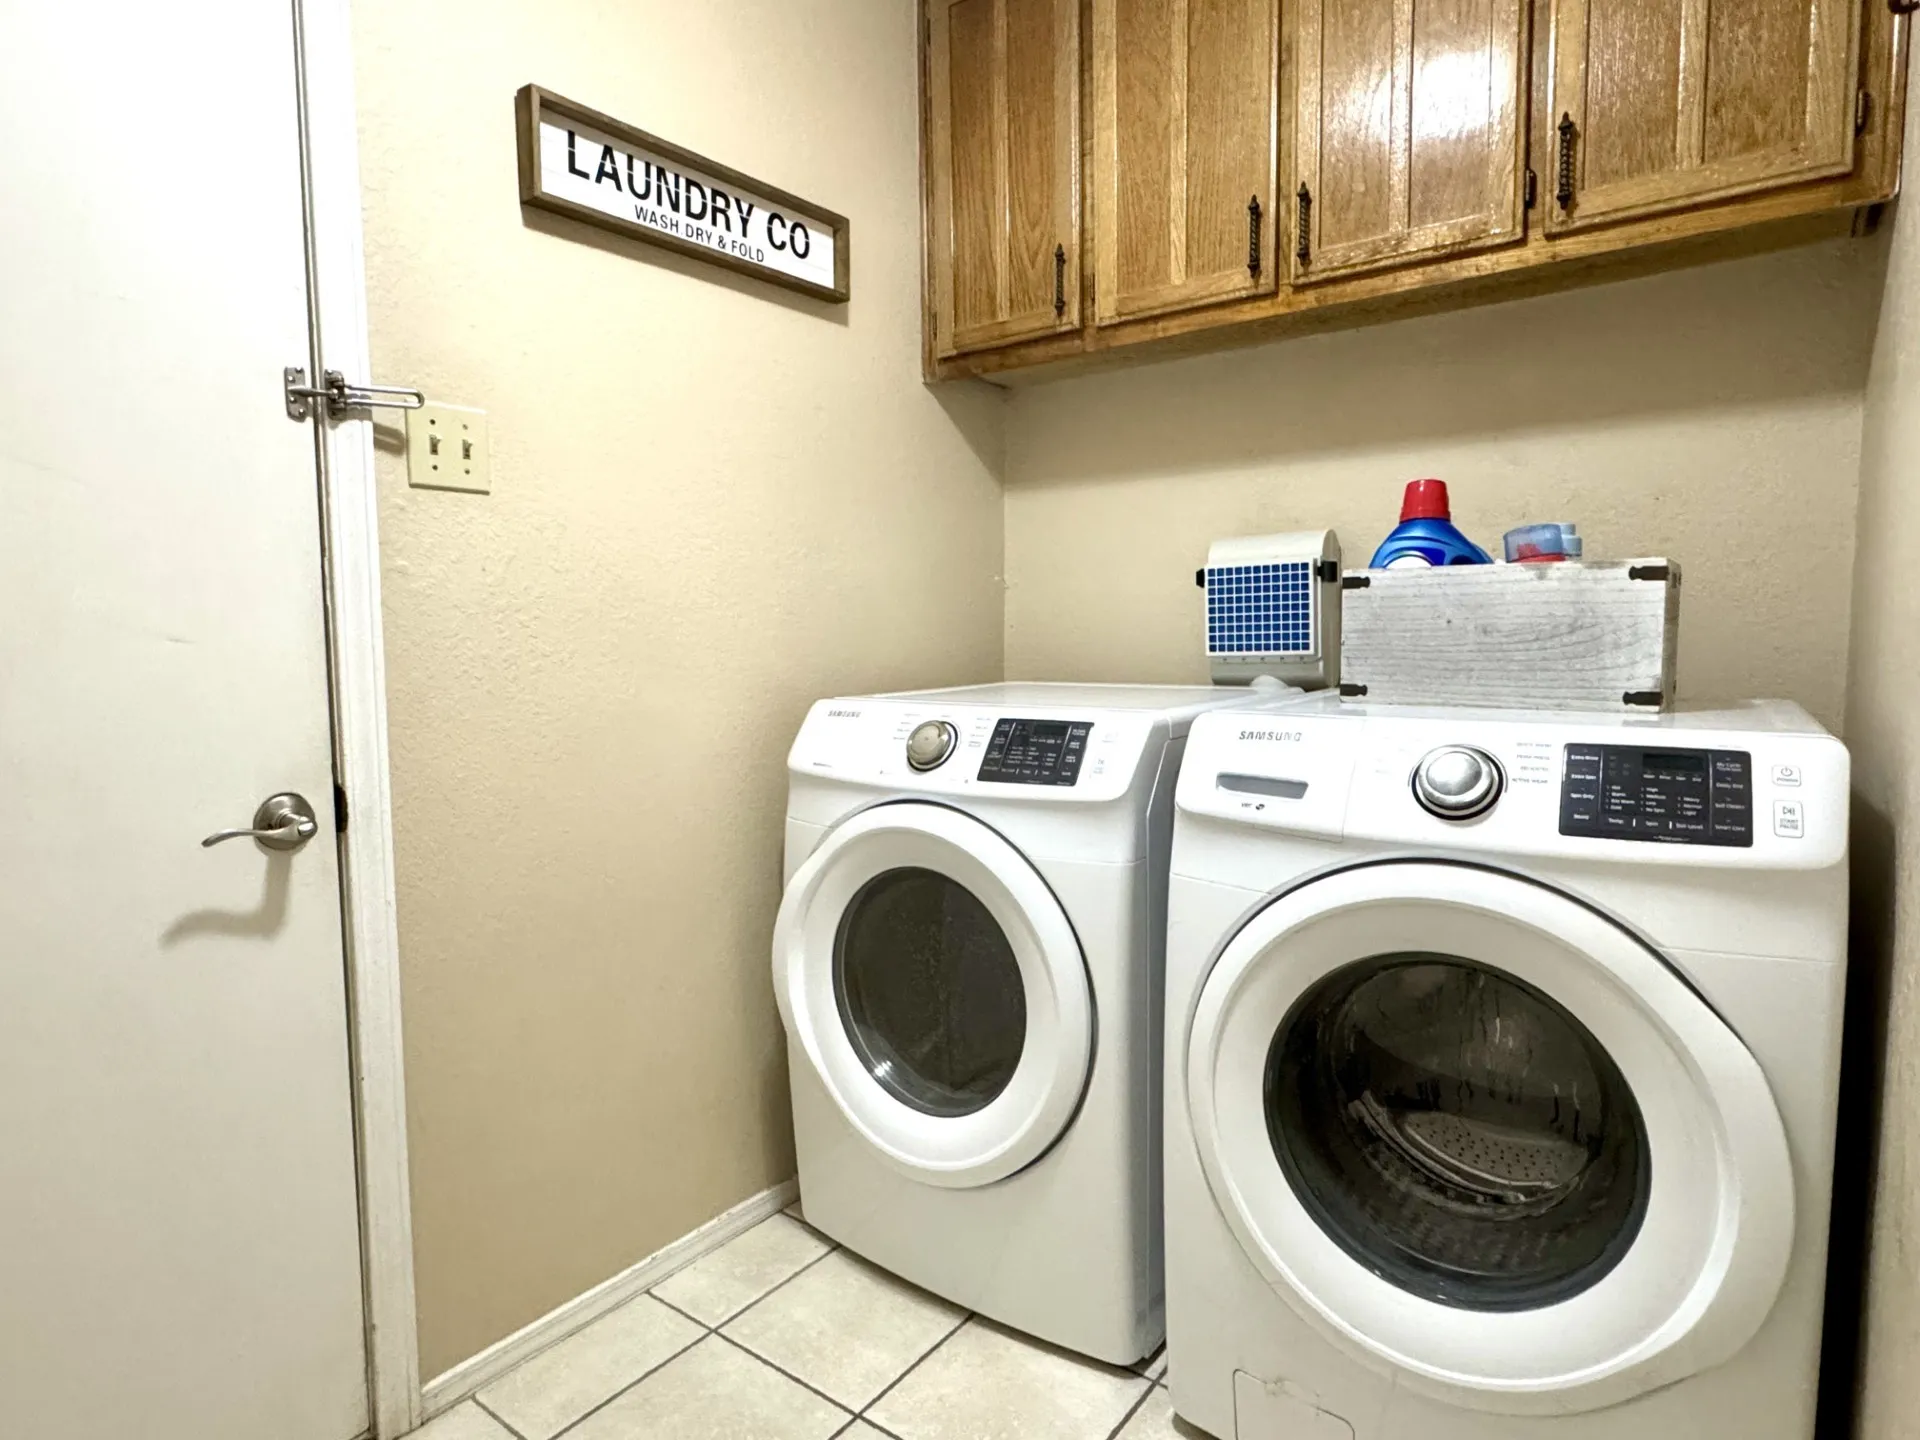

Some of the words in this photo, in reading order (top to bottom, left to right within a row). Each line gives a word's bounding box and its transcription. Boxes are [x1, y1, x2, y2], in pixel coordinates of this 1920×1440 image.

[568, 130, 755, 239] LAUNDRY
[766, 212, 811, 260] CO
[685, 223, 713, 245] DRY
[718, 235, 727, 250] &
[731, 240, 764, 262] FOLD
[827, 710, 862, 719] SAMSUNG
[1238, 730, 1302, 742] SAMSUNG
